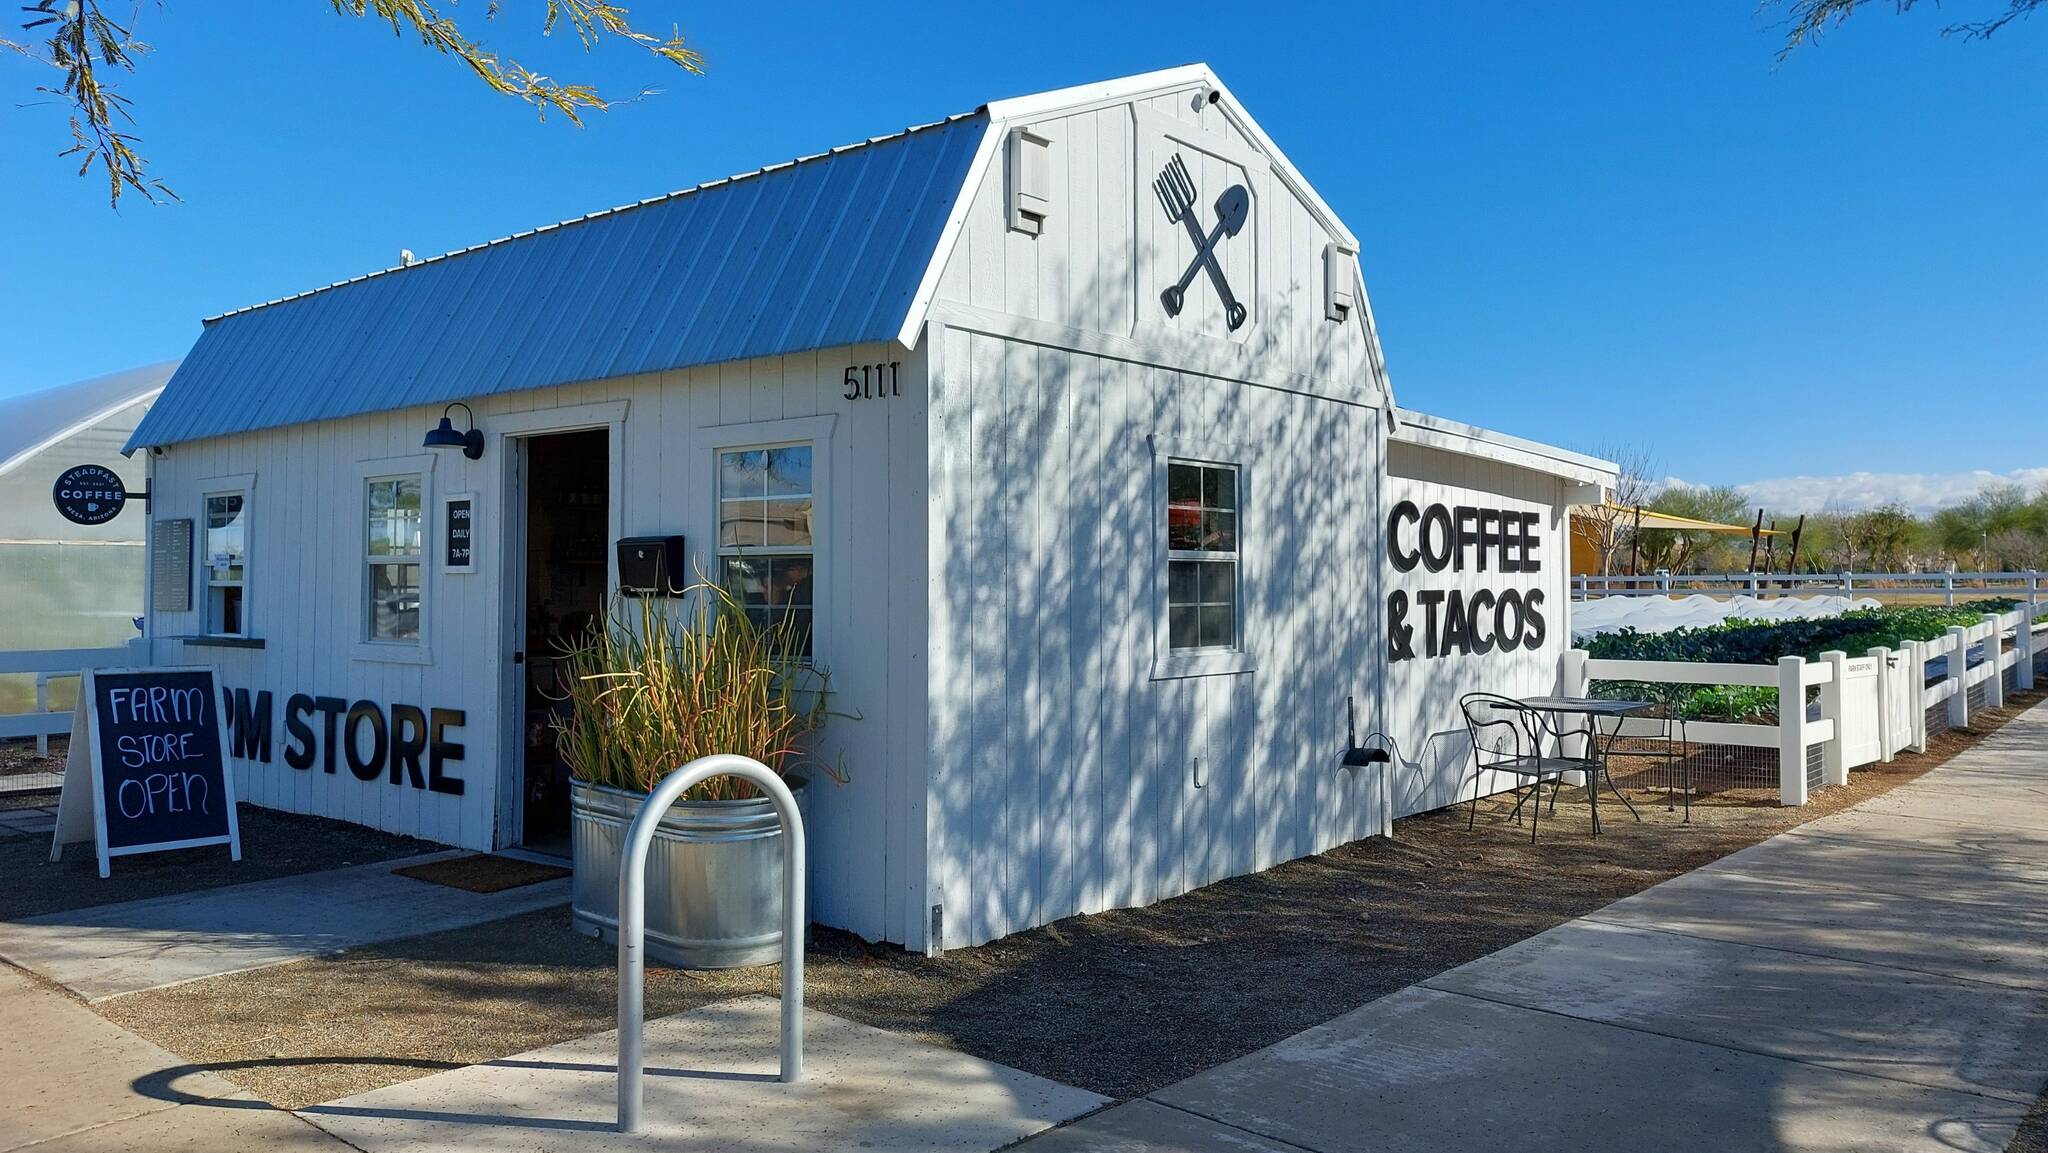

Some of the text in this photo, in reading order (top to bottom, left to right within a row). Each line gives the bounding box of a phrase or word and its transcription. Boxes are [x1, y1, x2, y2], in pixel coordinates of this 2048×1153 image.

[843, 361, 899, 400] 5111
[64, 468, 120, 488] STEADFAST
[61, 490, 122, 500] COFFEE
[453, 509, 470, 519] OPEN
[452, 529, 470, 538] DAILY
[1387, 500, 1541, 573] COFFEE
[452, 548, 470, 558] 7A-7P
[1387, 588, 1546, 663] & TACOS
[117, 732, 204, 768] STORE
[284, 693, 466, 796] STORE
